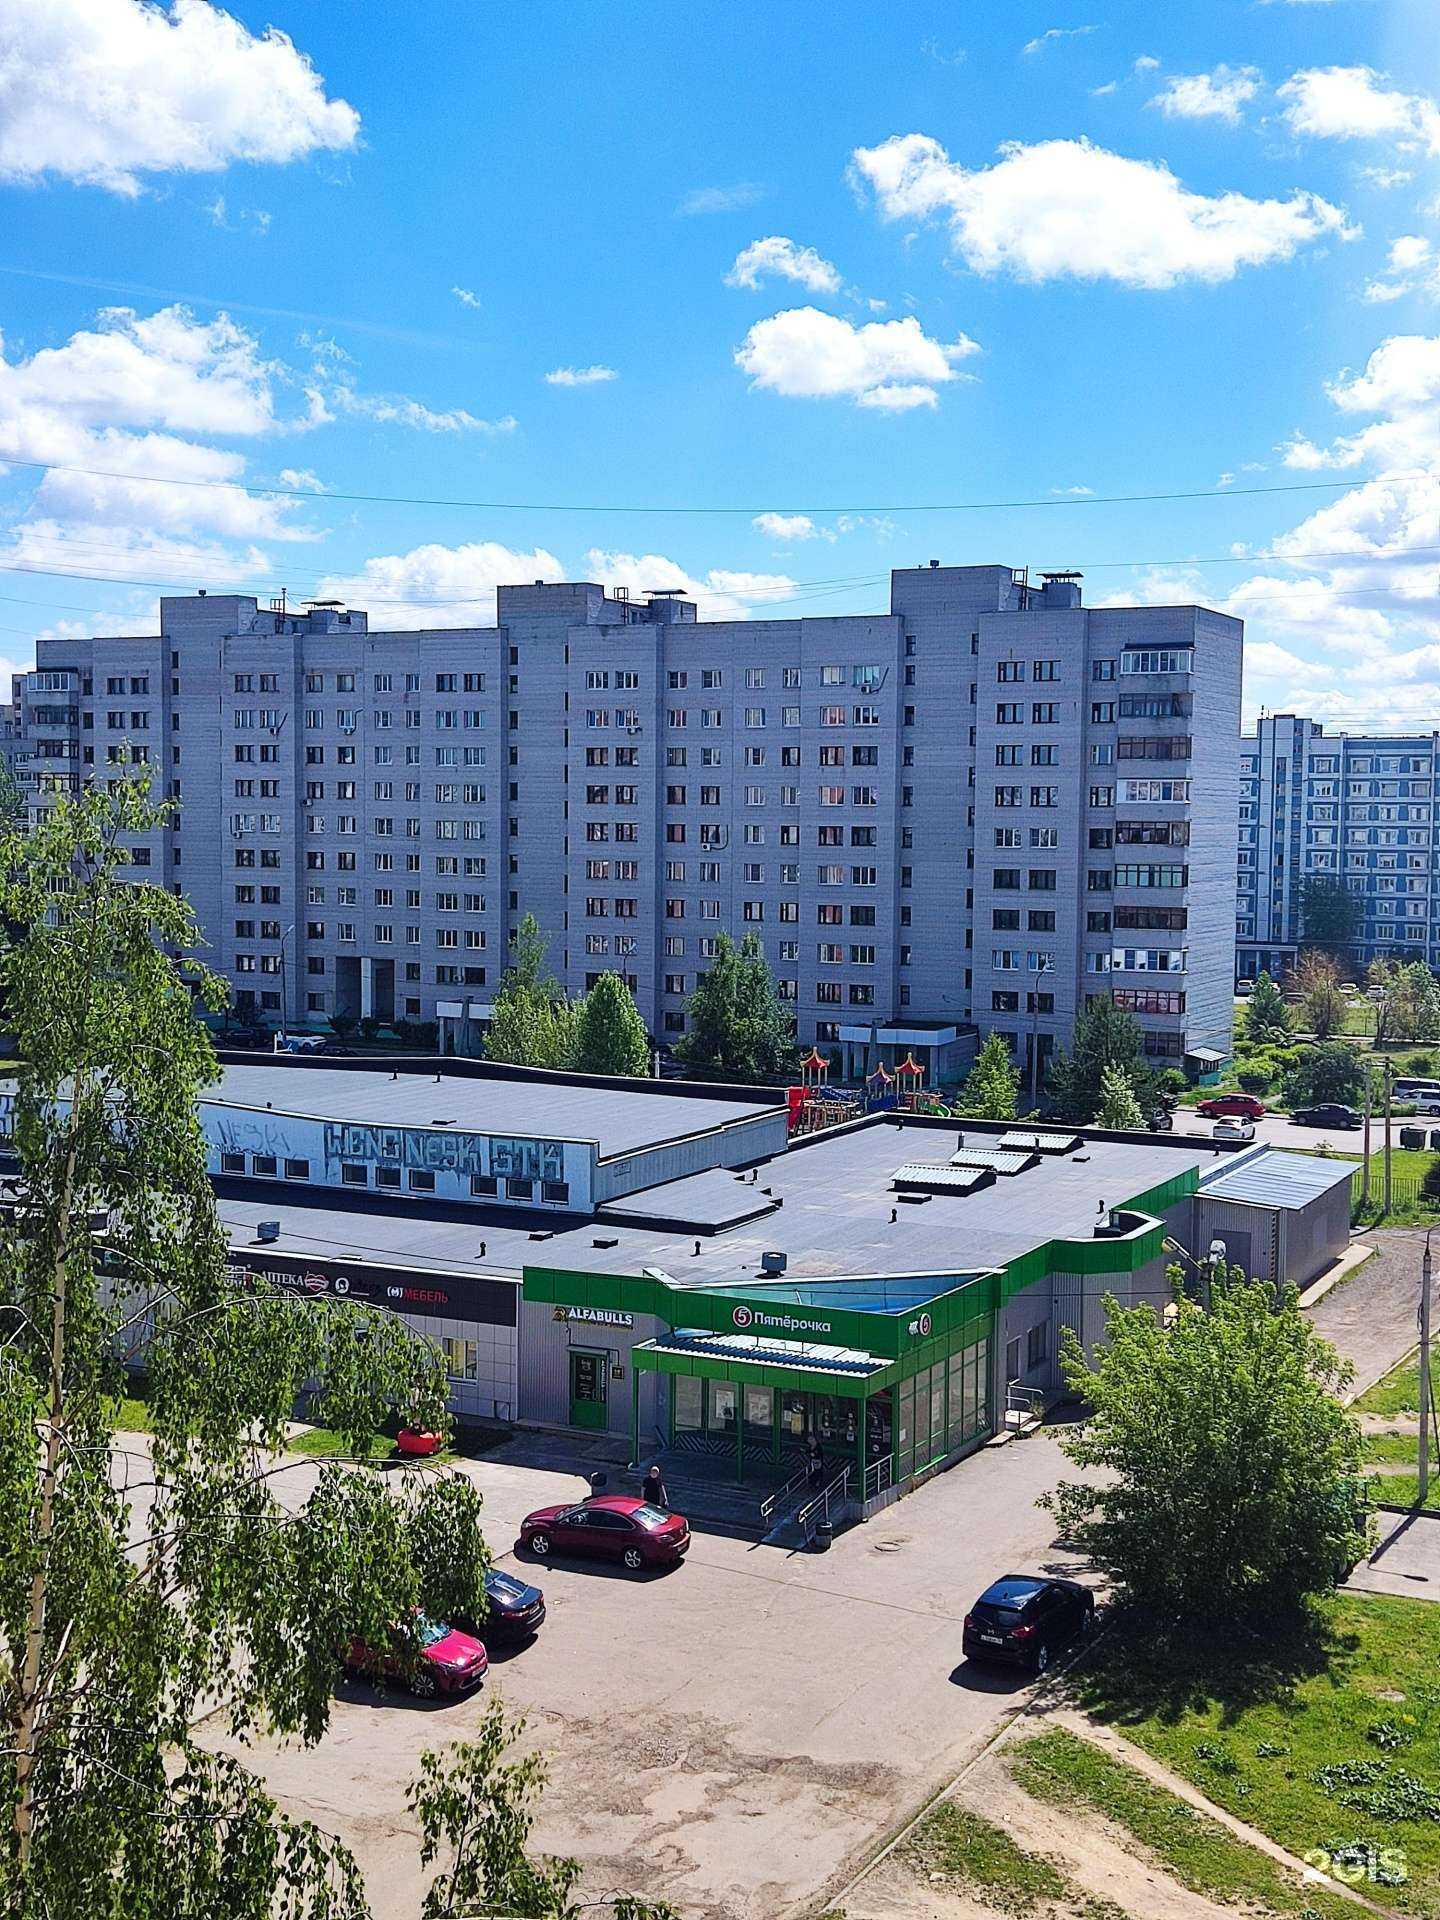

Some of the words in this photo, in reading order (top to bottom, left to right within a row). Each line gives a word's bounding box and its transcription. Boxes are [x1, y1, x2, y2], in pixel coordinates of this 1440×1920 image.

[261, 1270, 304, 1286] АПТЕКА
[568, 1307, 633, 1325] ALFABULLS
[753, 1311, 832, 1332] Пятёрочка
